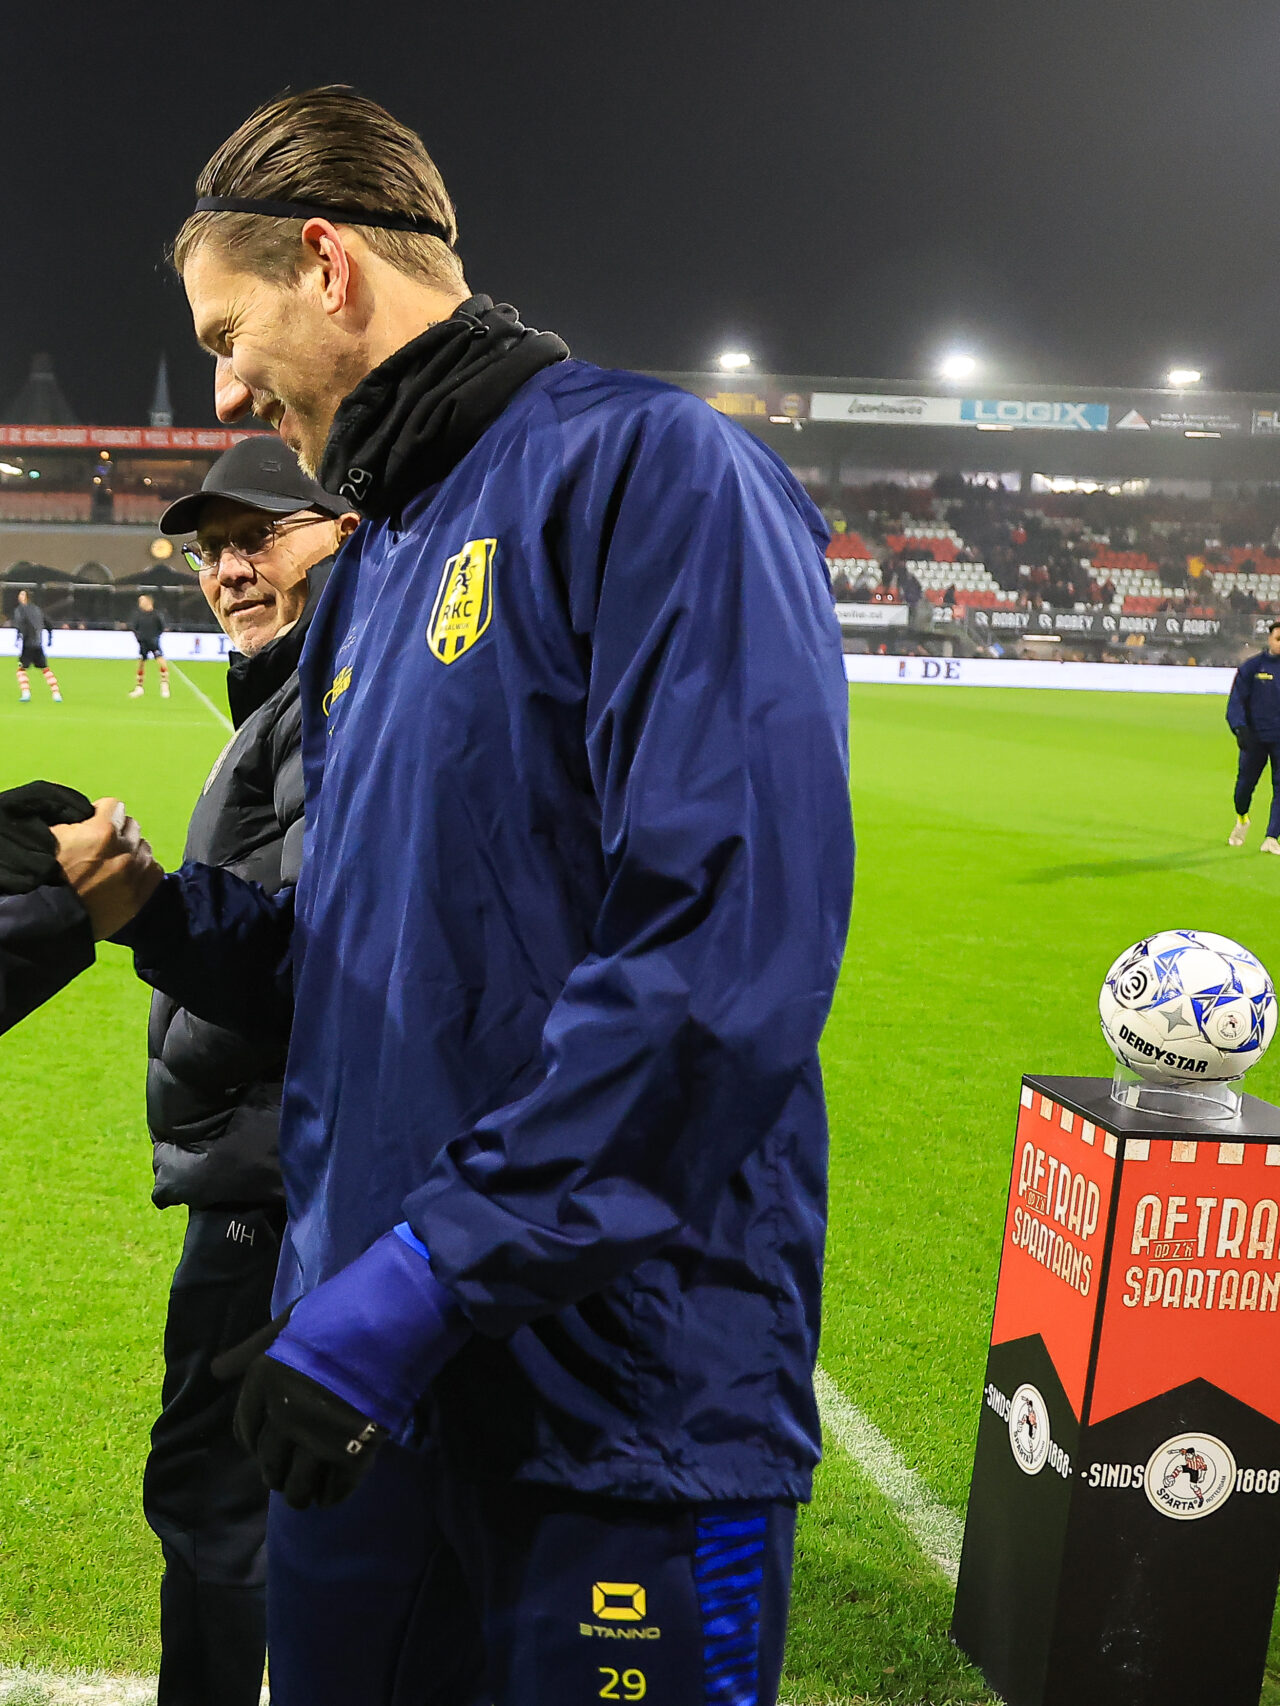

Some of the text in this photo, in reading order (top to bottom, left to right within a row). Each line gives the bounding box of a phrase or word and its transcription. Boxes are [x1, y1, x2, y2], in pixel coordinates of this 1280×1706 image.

[975, 401, 1092, 429] LOGIX
[338, 466, 373, 501] 29
[442, 600, 473, 620] RKC
[922, 659, 961, 680] DE
[1118, 1024, 1209, 1073] DERBYSTAR
[1018, 1141, 1100, 1242] AFTRAP
[226, 1220, 256, 1247] NH
[1130, 1193, 1280, 1260] AFTRA
[1011, 1206, 1094, 1297] SPARTAANS
[1154, 1243, 1170, 1259] OP
[579, 1622, 661, 1640] STANNO
[598, 1666, 648, 1701] 29
